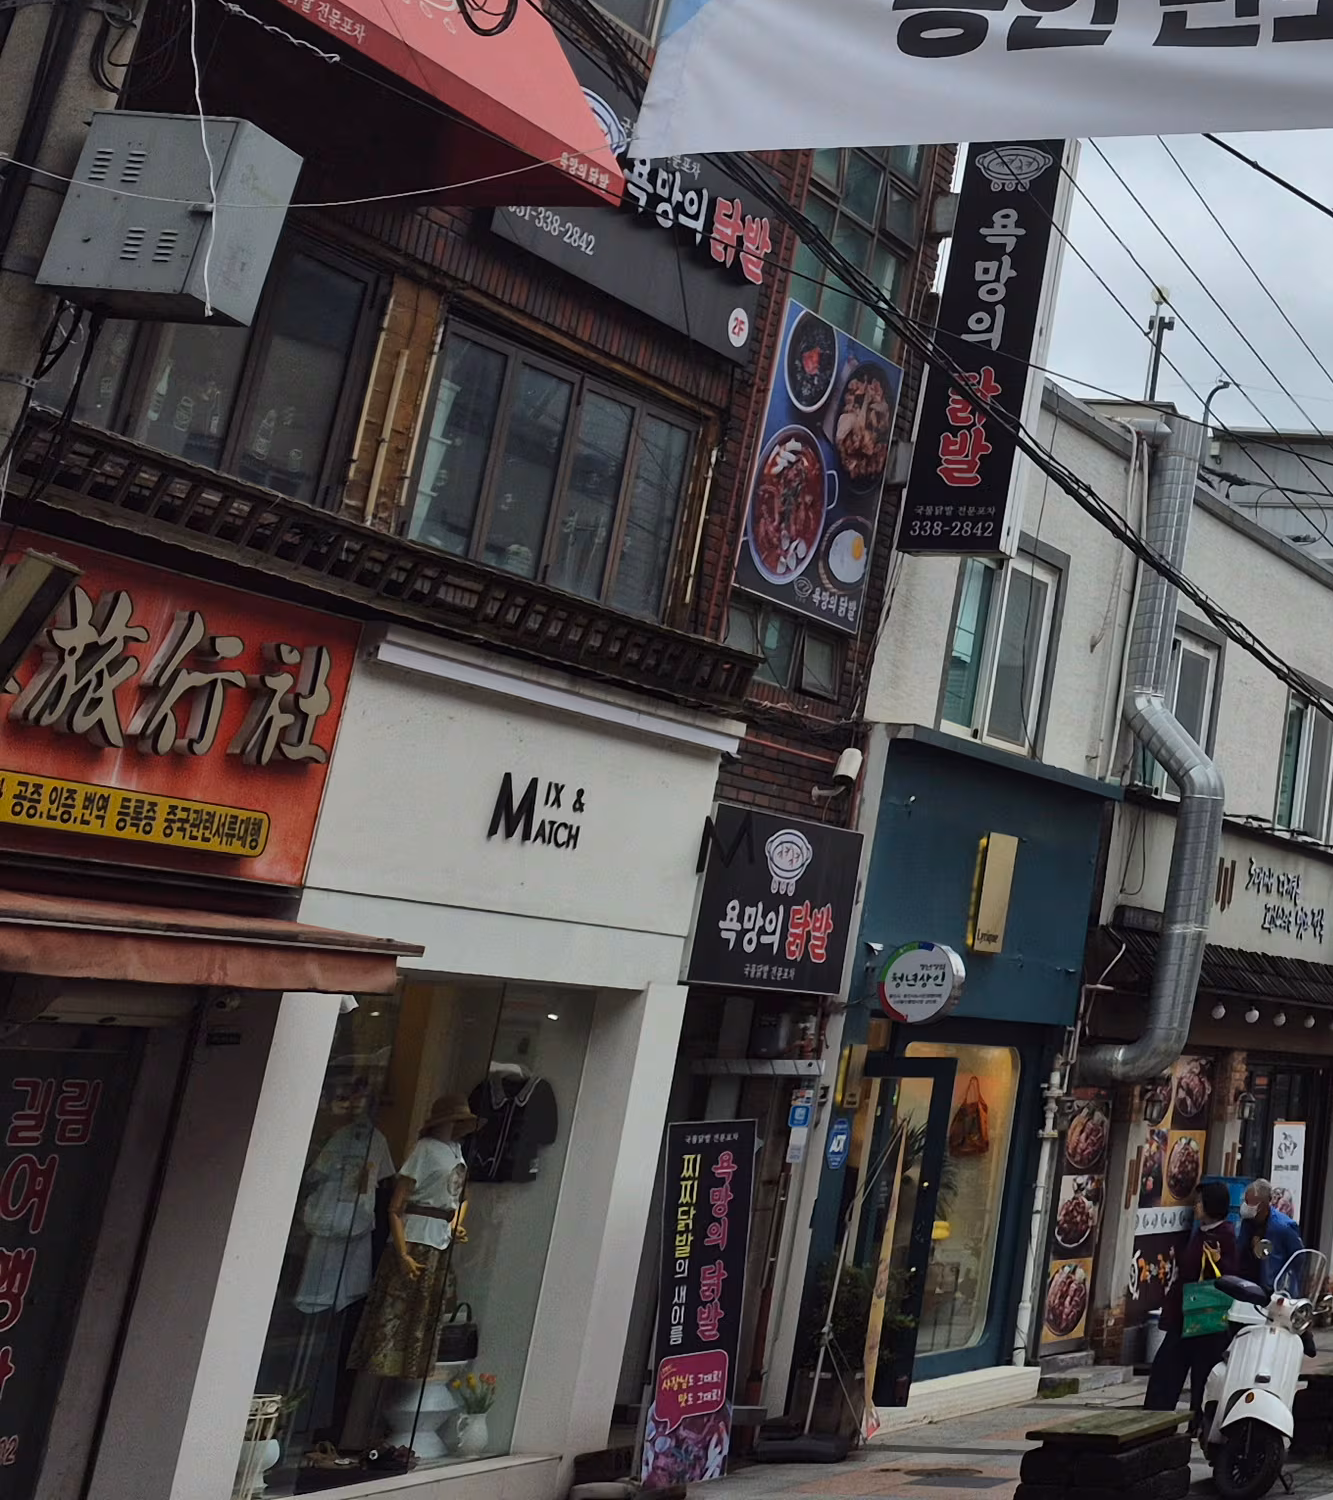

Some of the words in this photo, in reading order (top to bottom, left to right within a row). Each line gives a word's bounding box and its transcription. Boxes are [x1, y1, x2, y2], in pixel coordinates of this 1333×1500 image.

[316, 0, 367, 45] 전문포차
[625, 156, 709, 248] 욕망의
[709, 195, 772, 287] 닭발
[958, 207, 1028, 352] 욕망의
[728, 314, 747, 339] 2F
[935, 365, 1003, 489] 닭발
[908, 519, 995, 539] 338-2842
[812, 586, 839, 614] 욕망의
[14, 584, 332, 767] 旅行社
[115, 796, 159, 836] 등록증
[163, 804, 264, 851] 중국관련서류대행
[718, 898, 784, 956] 욕망의
[785, 899, 834, 964] 닭발
[891, 970, 946, 989] 청년상인
[6, 1077, 104, 1147] 길림
[703, 1150, 738, 1251] 욕망의
[669, 1283, 688, 1346] 새이름
[696, 1259, 729, 1343] 닭발
